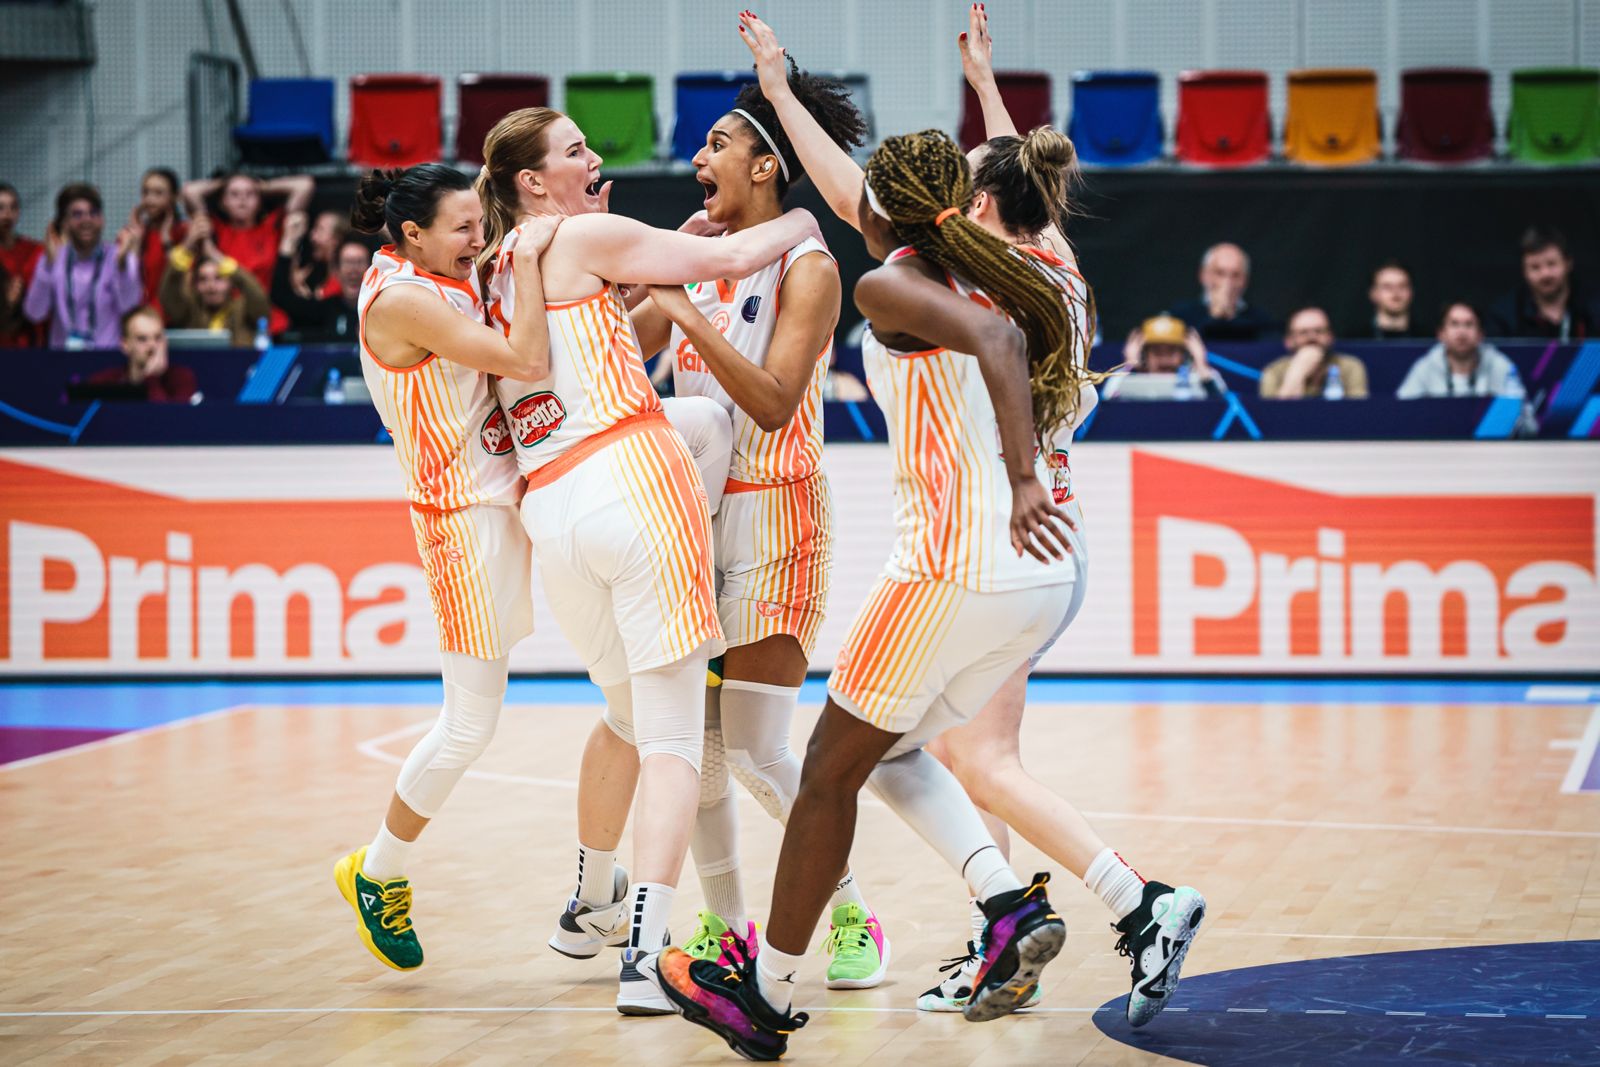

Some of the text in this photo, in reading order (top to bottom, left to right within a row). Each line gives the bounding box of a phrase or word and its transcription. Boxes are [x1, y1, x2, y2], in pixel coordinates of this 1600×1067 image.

[513, 398, 565, 442] Bretta
[9, 520, 437, 660] Prima
[1158, 514, 1597, 659] Prima
